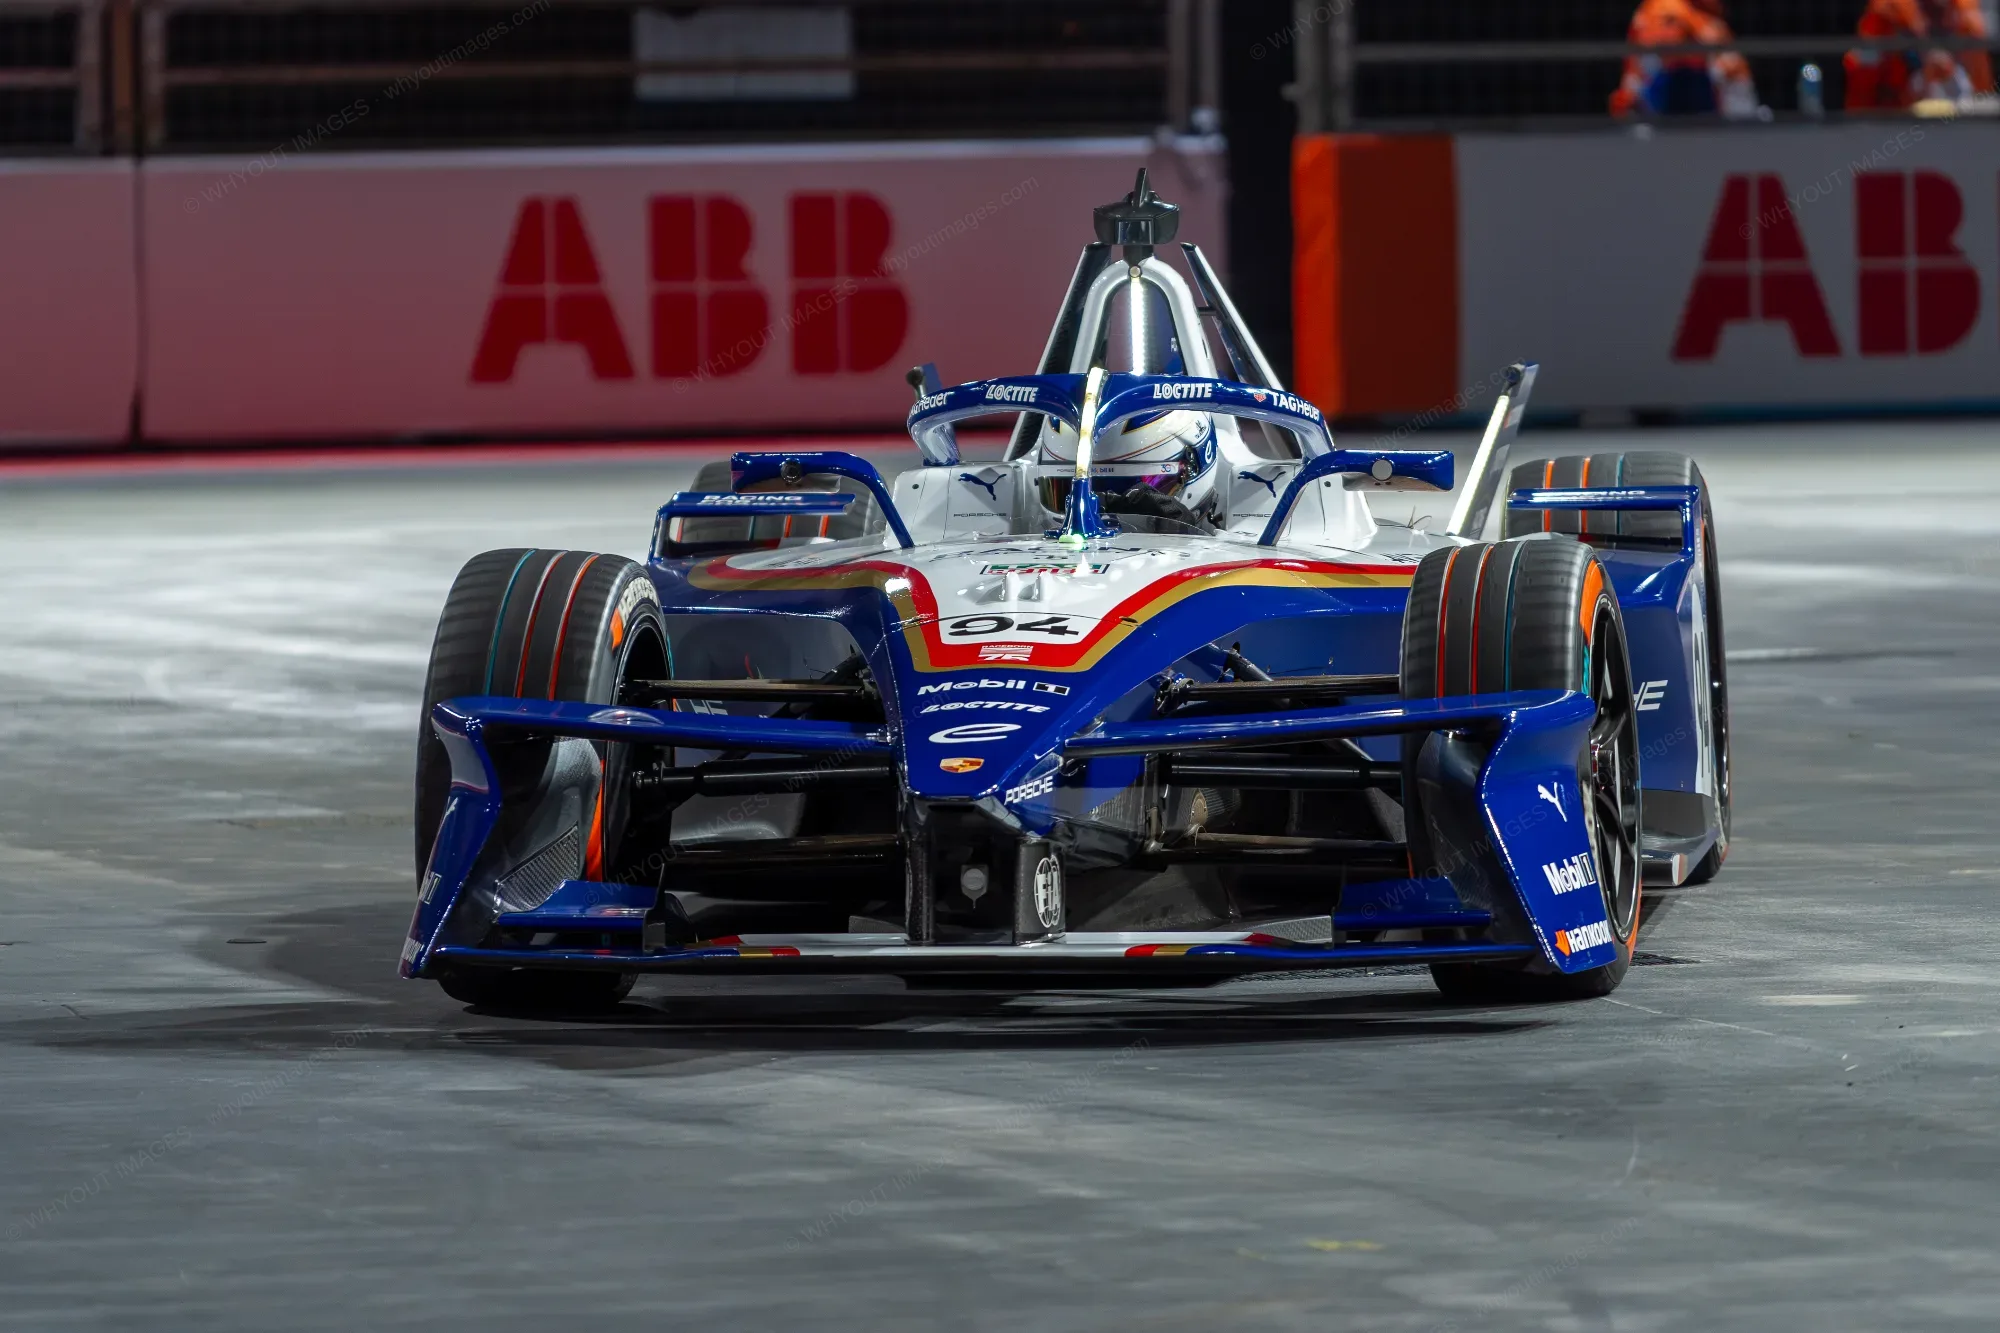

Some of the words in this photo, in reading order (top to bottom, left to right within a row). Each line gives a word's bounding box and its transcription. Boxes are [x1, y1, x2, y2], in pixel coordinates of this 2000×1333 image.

[1669, 168, 2000, 364] AB
[468, 190, 911, 383] ABB
[985, 385, 1039, 402] LOCTITE
[1153, 383, 1213, 399] LOCTITE
[948, 616, 1080, 636] 94
[917, 678, 1027, 696] Mobil
[919, 700, 1051, 714] LOCTITE
[1004, 775, 1054, 805] PORSCHE
[1542, 855, 1588, 895] Mobil
